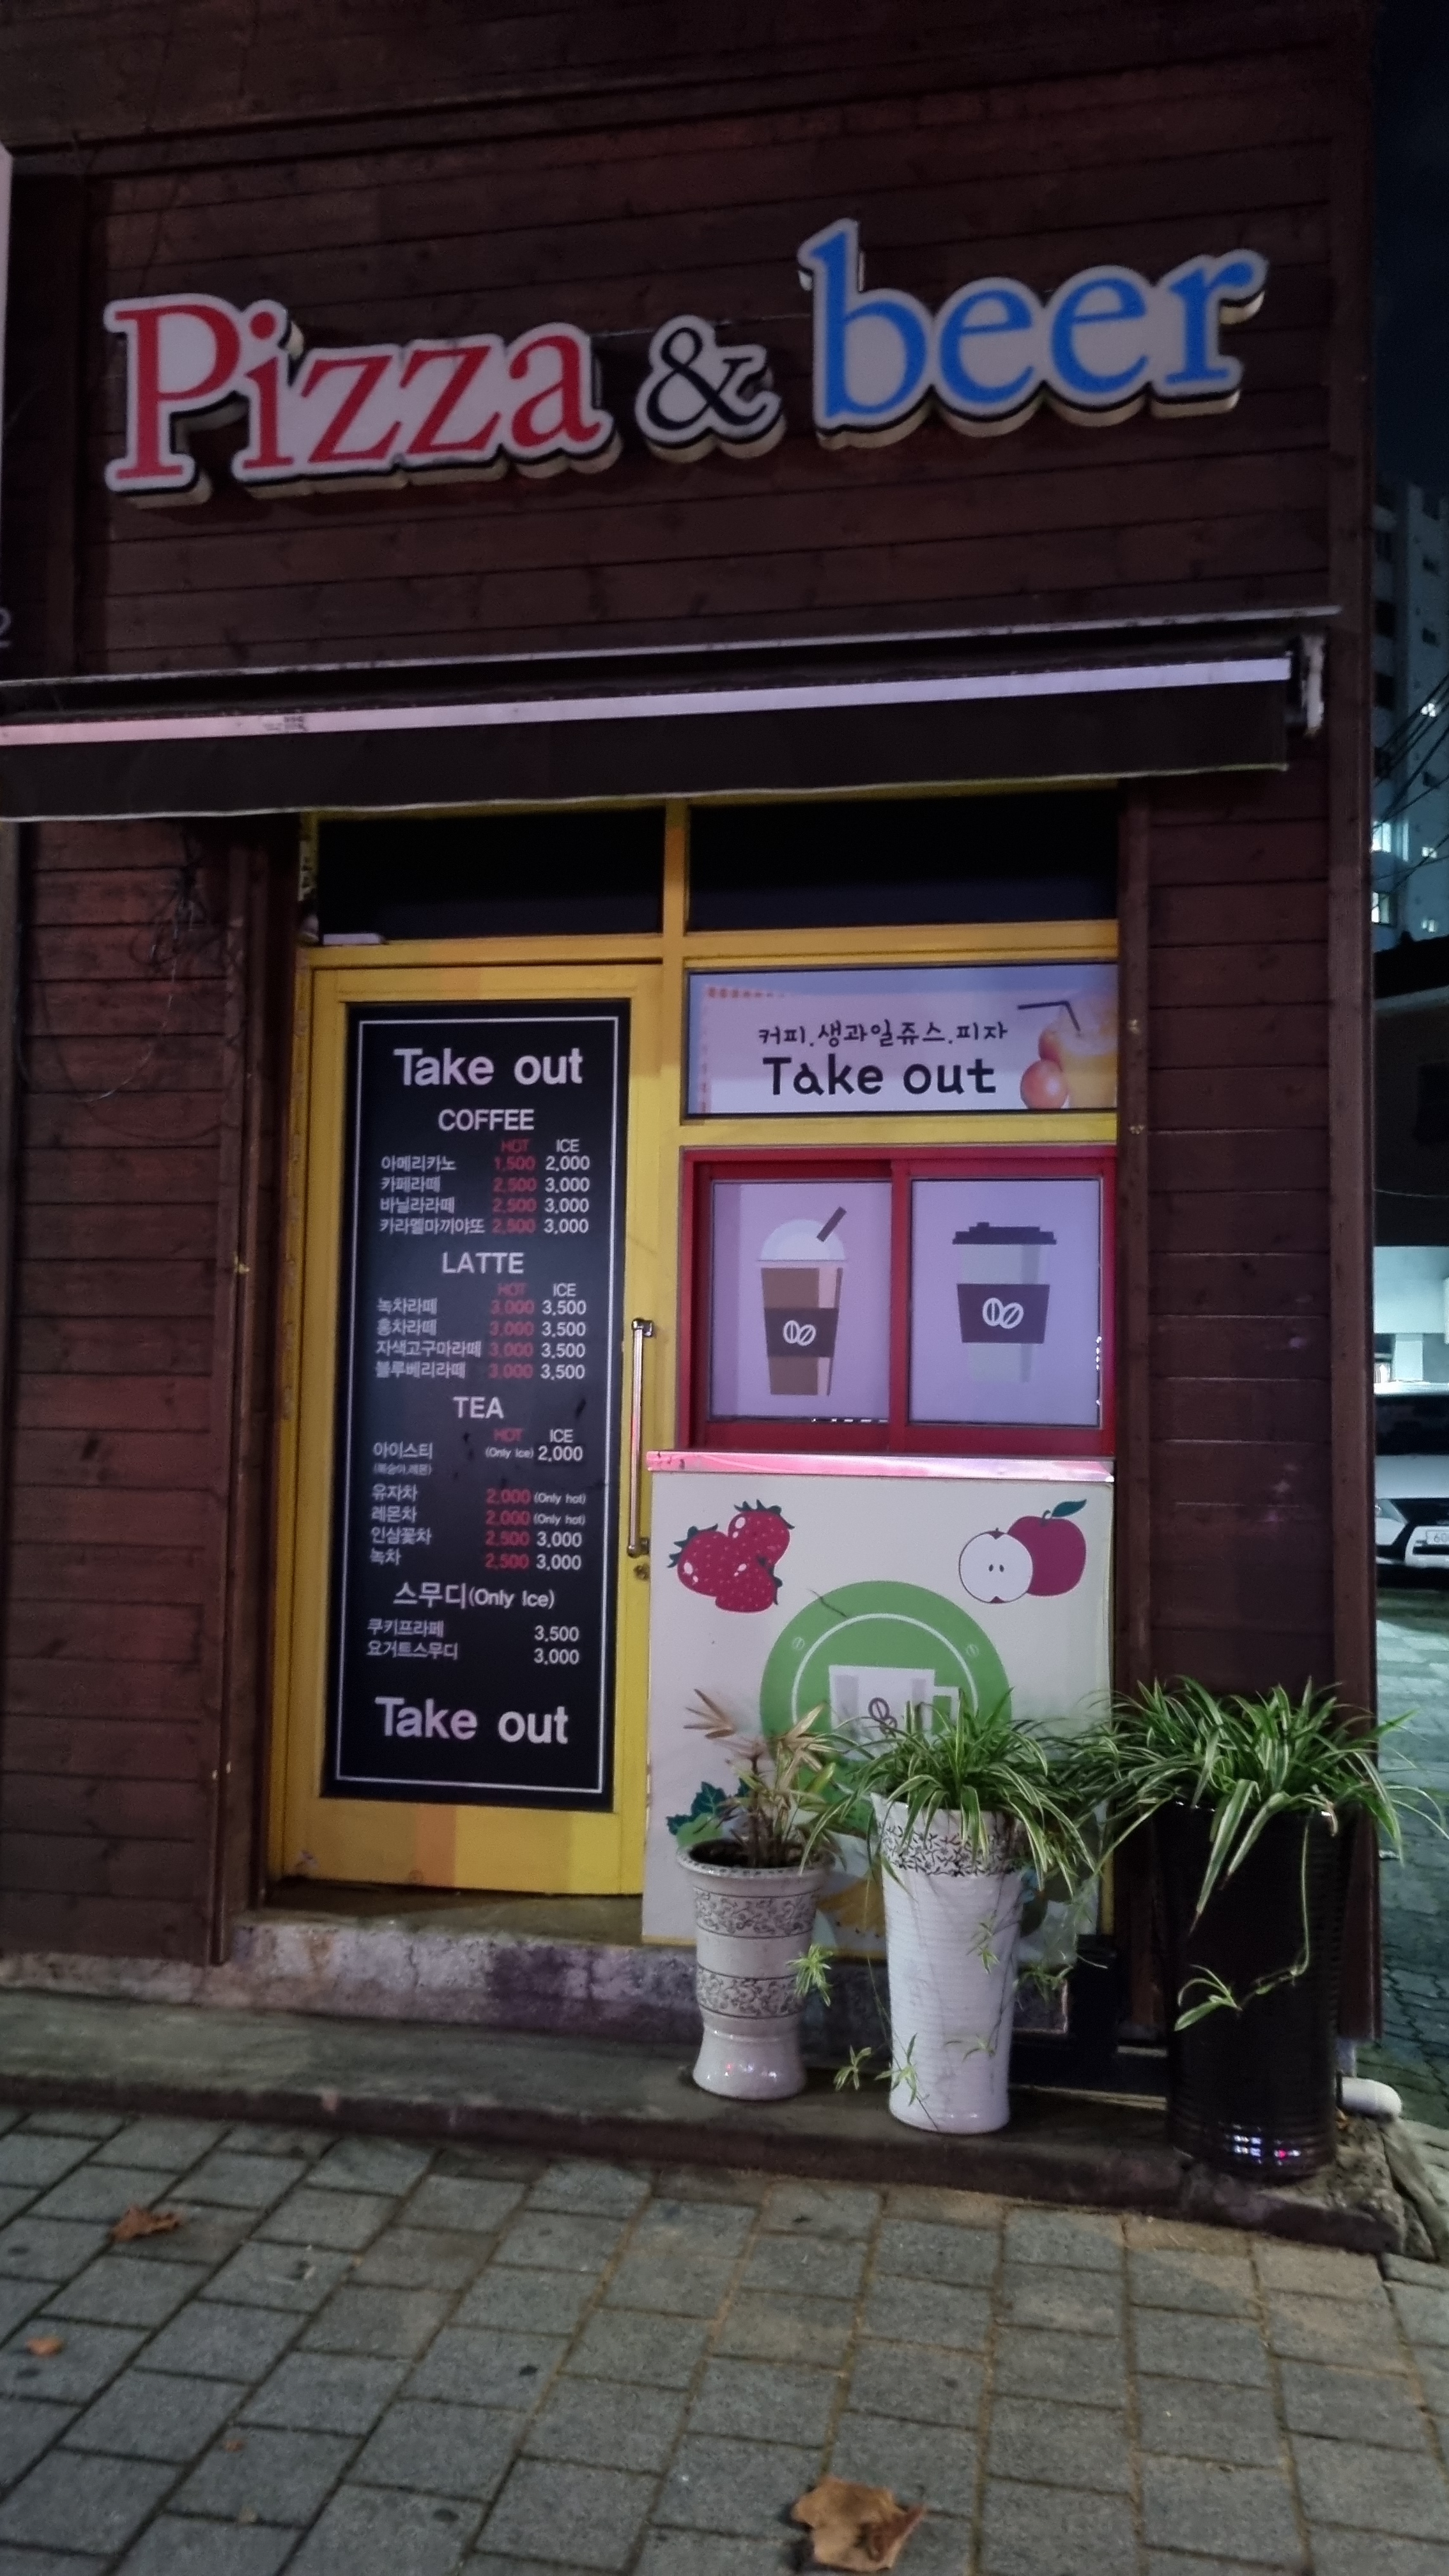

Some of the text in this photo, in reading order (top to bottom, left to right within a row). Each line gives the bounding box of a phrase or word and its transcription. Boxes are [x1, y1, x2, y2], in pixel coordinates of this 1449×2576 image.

[111, 227, 1257, 483] Pizza & beer
[393, 1048, 583, 1086] Take out
[762, 1053, 997, 1096] Take out
[438, 1108, 535, 1131] COFFEE
[501, 1138, 579, 1153] HOT ICE
[380, 1154, 457, 1172] 아메리카노
[379, 1176, 441, 1193] 카페라떼
[379, 1197, 455, 1214] 바닐라라떼
[441, 1251, 525, 1275] LATTE
[497, 1282, 576, 1298] HOT ICE
[377, 1297, 438, 1315] 녹차라떼
[452, 1396, 504, 1419] TEA
[493, 1428, 574, 1443] HOT ICE
[373, 1441, 434, 1460] 아이스티
[371, 1483, 418, 1502] 유자차
[534, 1492, 562, 1505] (Only
[371, 1505, 418, 1523] 레몬차
[533, 1513, 562, 1526] (Only
[369, 1547, 402, 1566] 녹차
[367, 1618, 444, 1638] 쿠키프라페
[367, 1640, 459, 1660] 요거트스무디
[374, 1696, 569, 1744] Take out
